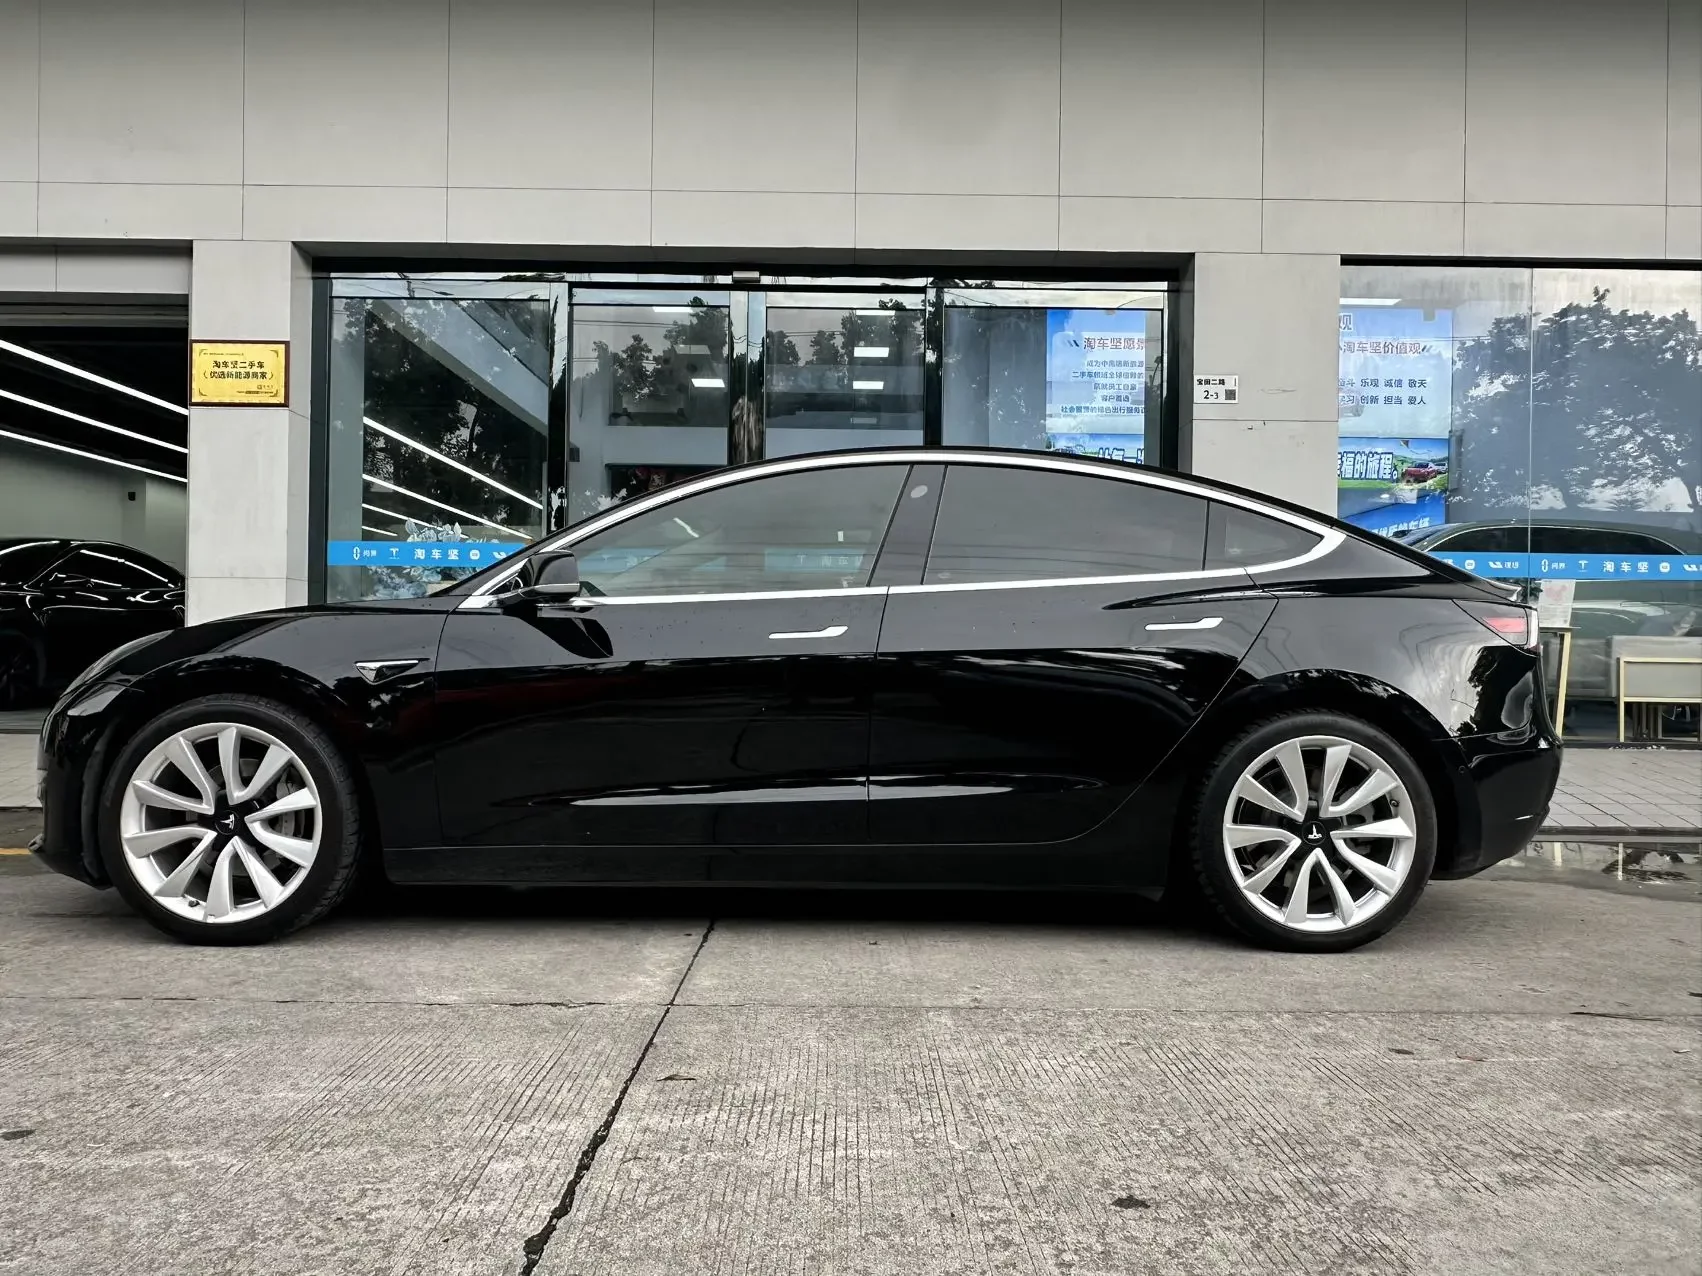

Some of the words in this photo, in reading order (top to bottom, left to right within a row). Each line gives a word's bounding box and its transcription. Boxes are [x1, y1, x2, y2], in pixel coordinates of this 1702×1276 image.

[1343, 341, 1421, 354] 淘车坚价值观
[1384, 378, 1403, 388] 诚信
[1408, 378, 1427, 388] 敬天
[1203, 389, 1219, 400] 2-3
[1360, 395, 1379, 405] 创新
[1384, 395, 1403, 405] 担当
[1408, 396, 1426, 405] 爱人
[414, 548, 459, 560] 淘车坚
[1603, 560, 1649, 573] 淘车坚
